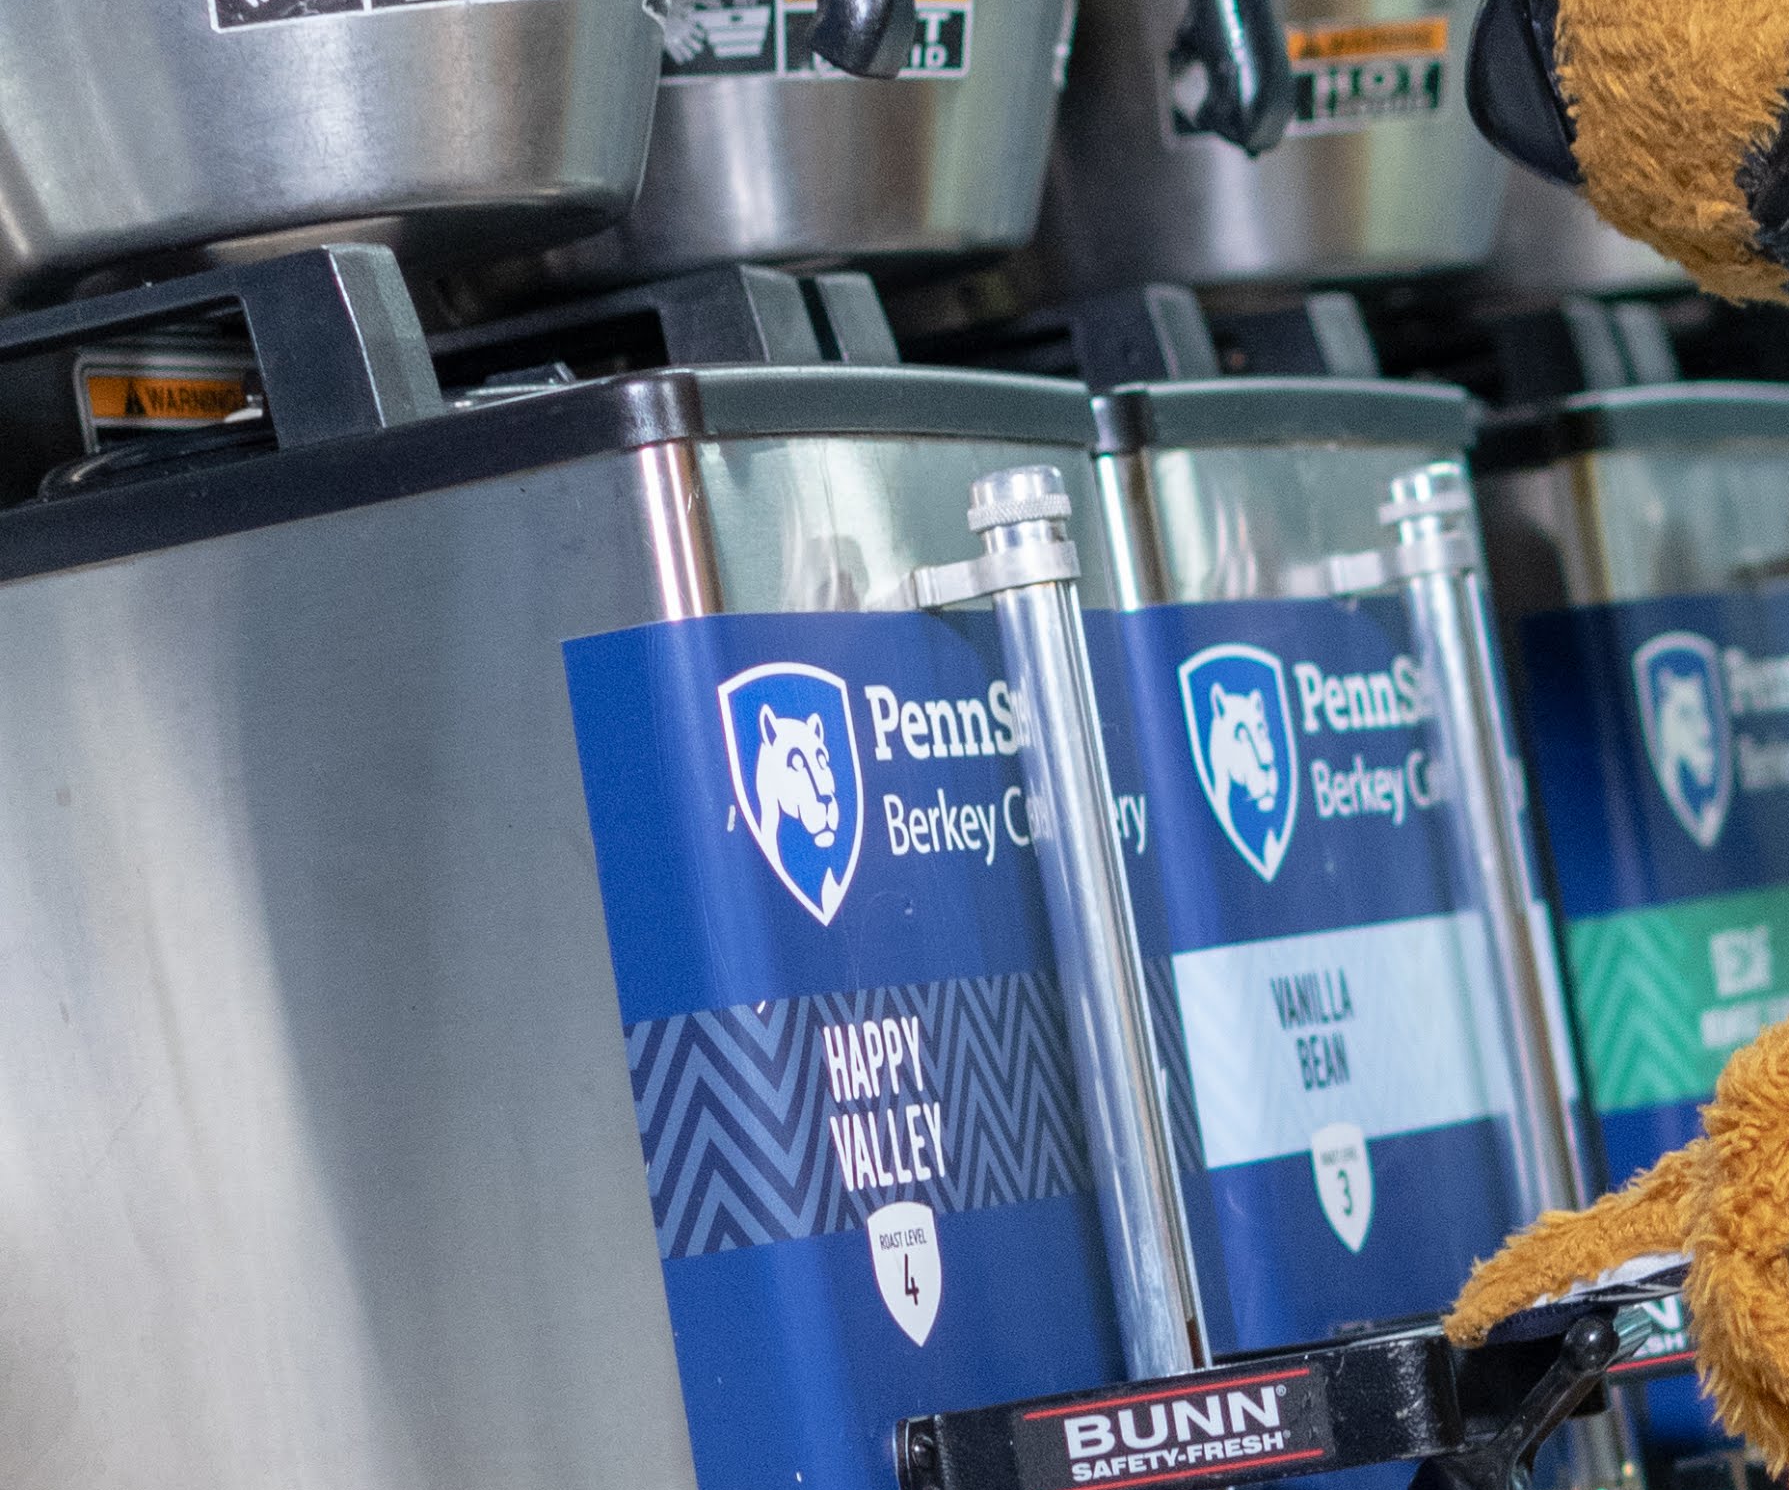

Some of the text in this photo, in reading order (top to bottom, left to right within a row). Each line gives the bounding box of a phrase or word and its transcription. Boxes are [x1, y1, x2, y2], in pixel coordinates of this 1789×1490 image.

[1311, 753, 1404, 825] Berkey
[882, 787, 996, 866] Berkey
[1270, 966, 1355, 1030] VANILLA
[823, 1015, 924, 1103] HAPPY
[1295, 1031, 1350, 1091] BEAN
[829, 1101, 946, 1192] VALLEY
[1337, 1168, 1354, 1217] 3
[879, 1227, 928, 1251] ROAST LEVEL
[904, 1253, 920, 1306] 4
